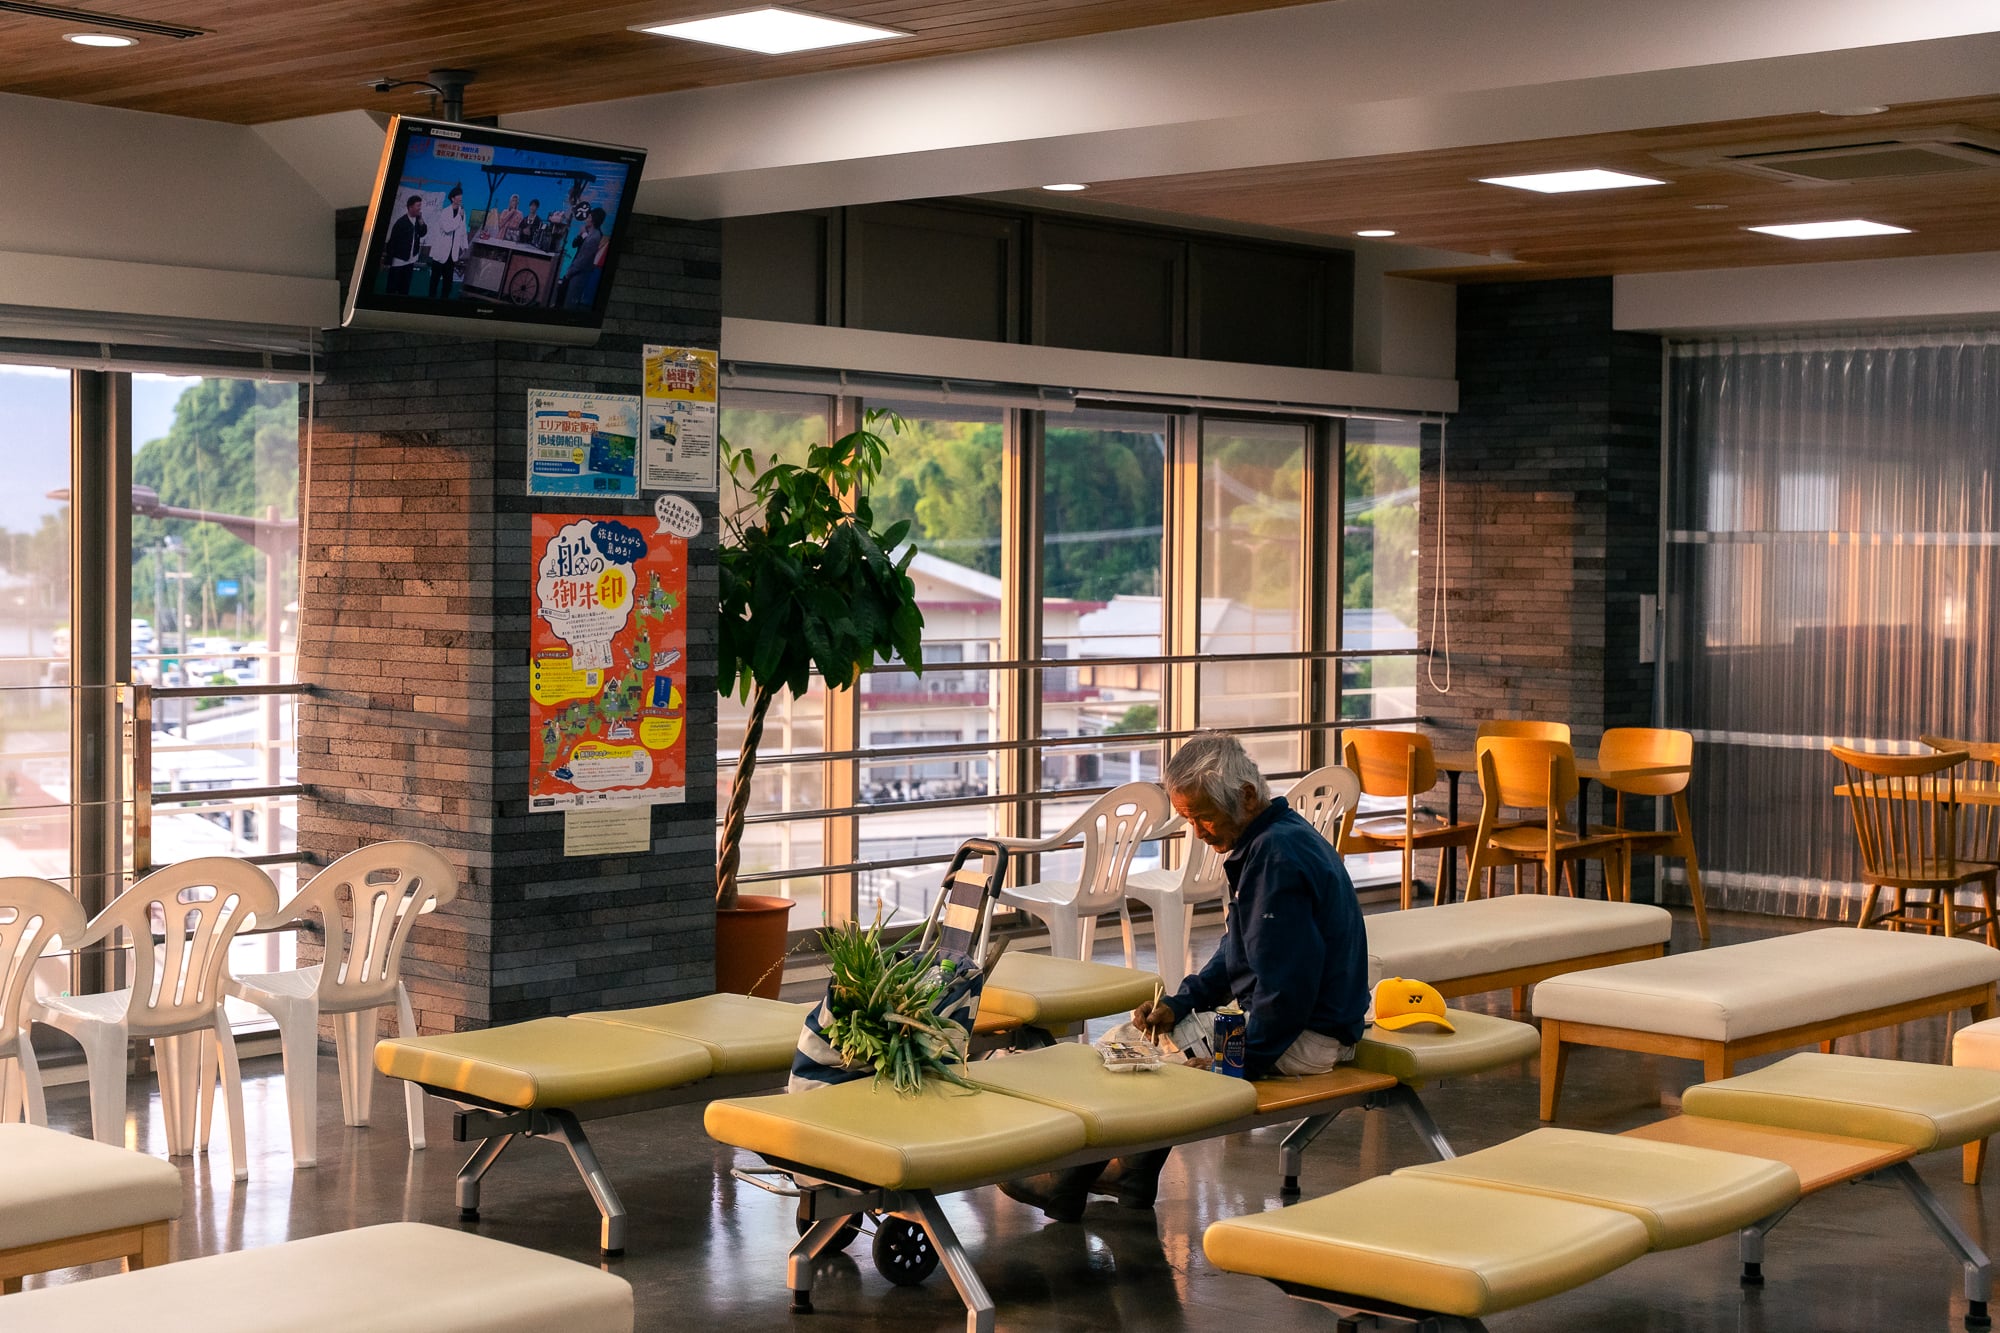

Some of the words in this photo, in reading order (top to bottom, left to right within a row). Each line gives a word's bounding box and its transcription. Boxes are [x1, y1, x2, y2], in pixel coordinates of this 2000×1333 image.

[538, 420, 599, 433] エリア限定販売
[537, 434, 583, 448] 地域御船印
[597, 528, 641, 548] 旅をしながら
[552, 575, 623, 610] 御朱印
